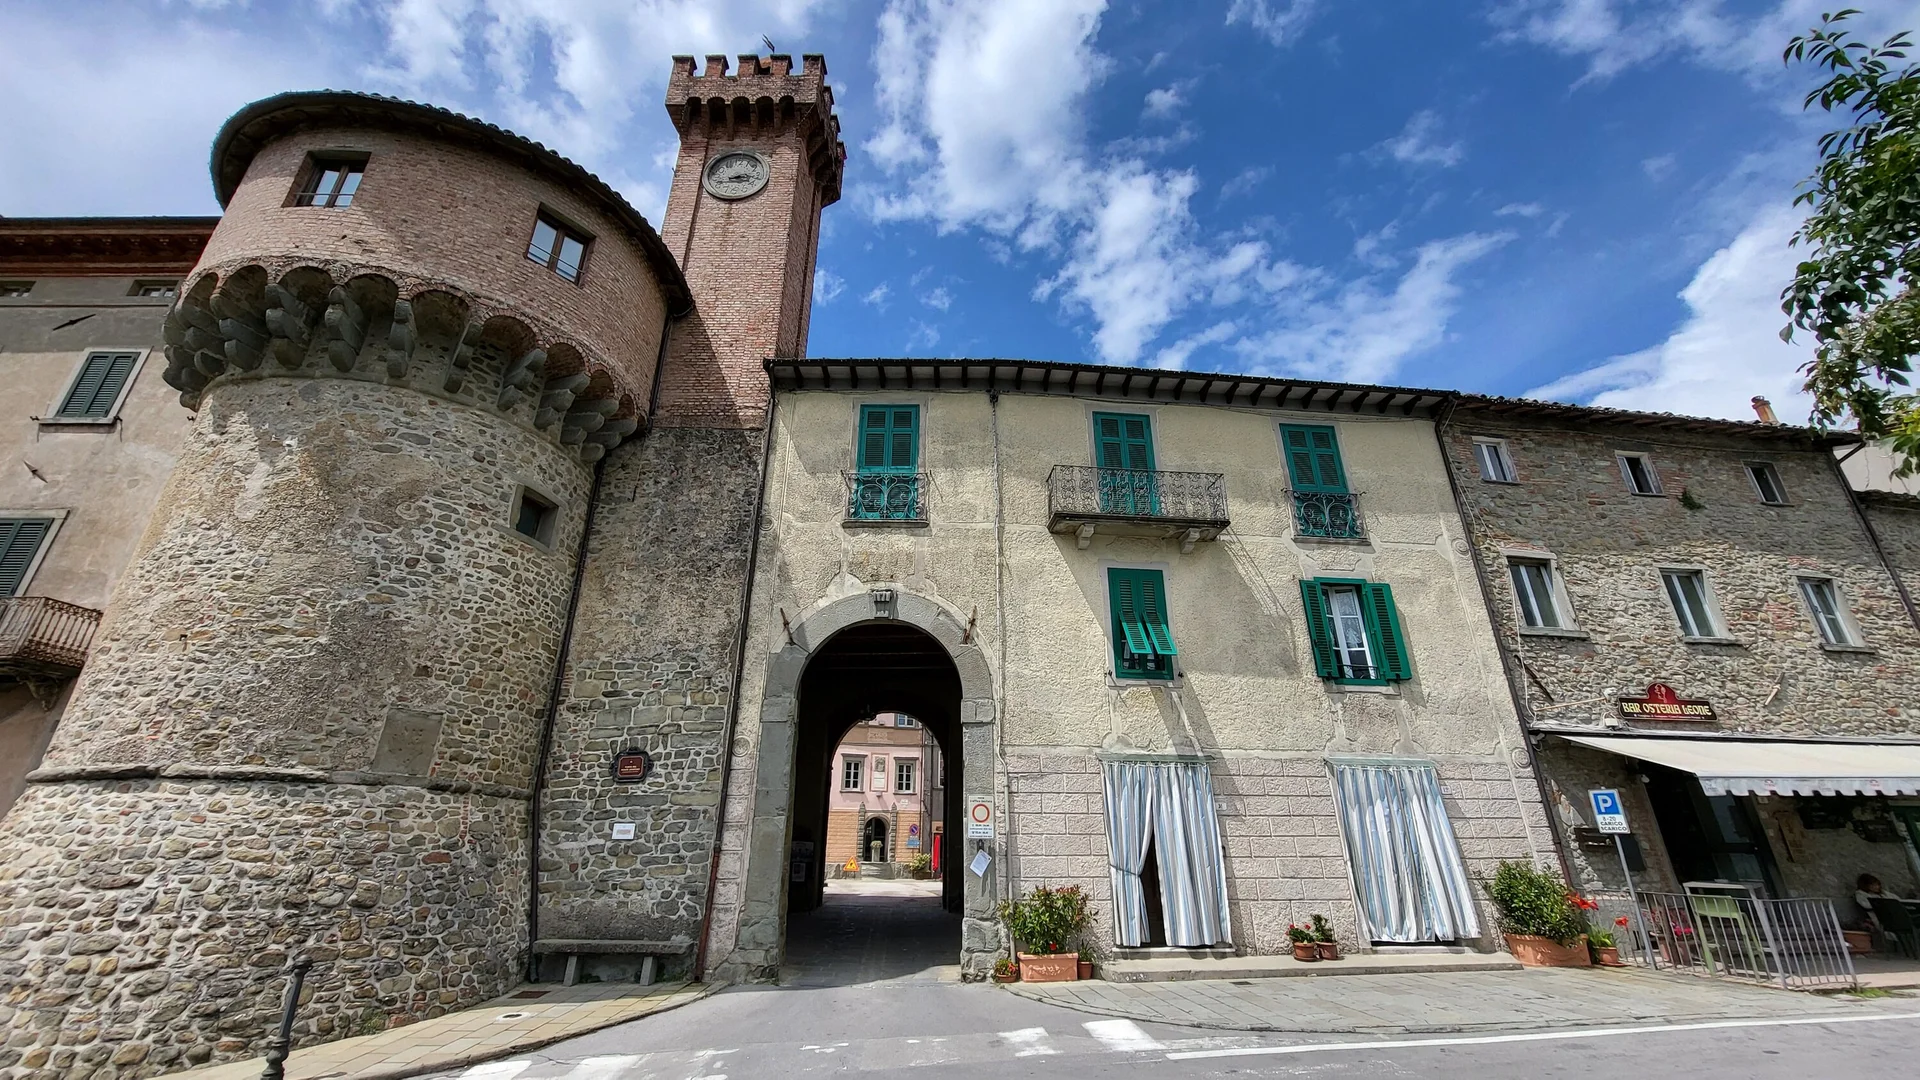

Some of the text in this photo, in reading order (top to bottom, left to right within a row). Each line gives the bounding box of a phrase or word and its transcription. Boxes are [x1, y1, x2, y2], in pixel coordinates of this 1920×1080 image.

[1621, 702, 1712, 715] BAR OSTERIA LEONE
[1597, 795, 1612, 812] P
